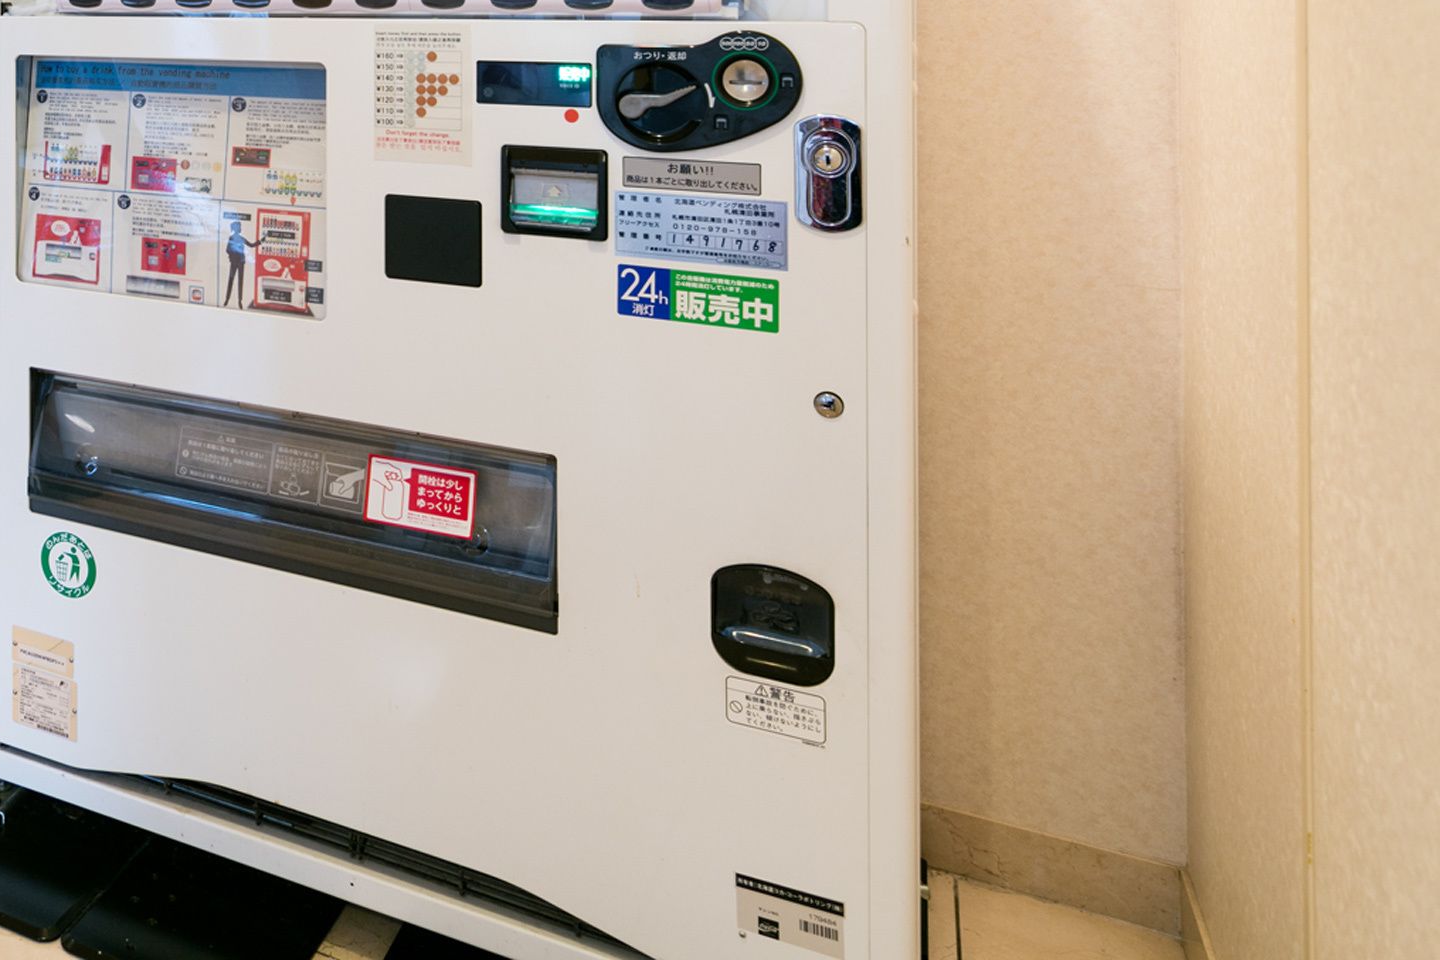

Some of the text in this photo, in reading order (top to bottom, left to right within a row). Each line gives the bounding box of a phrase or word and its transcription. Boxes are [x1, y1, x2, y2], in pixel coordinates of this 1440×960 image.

[633, 51, 687, 61] おつり・返却
[141, 67, 154, 76] the
[667, 163, 714, 176] お願い!!
[632, 303, 655, 317] 消灯
[675, 290, 774, 328] 販売中
[418, 474, 464, 491] 開栓は少し
[418, 486, 463, 503] まってから
[416, 498, 462, 515] ゆっくりと
[48, 575, 91, 597] リサイクル
[770, 687, 795, 704] 警告
